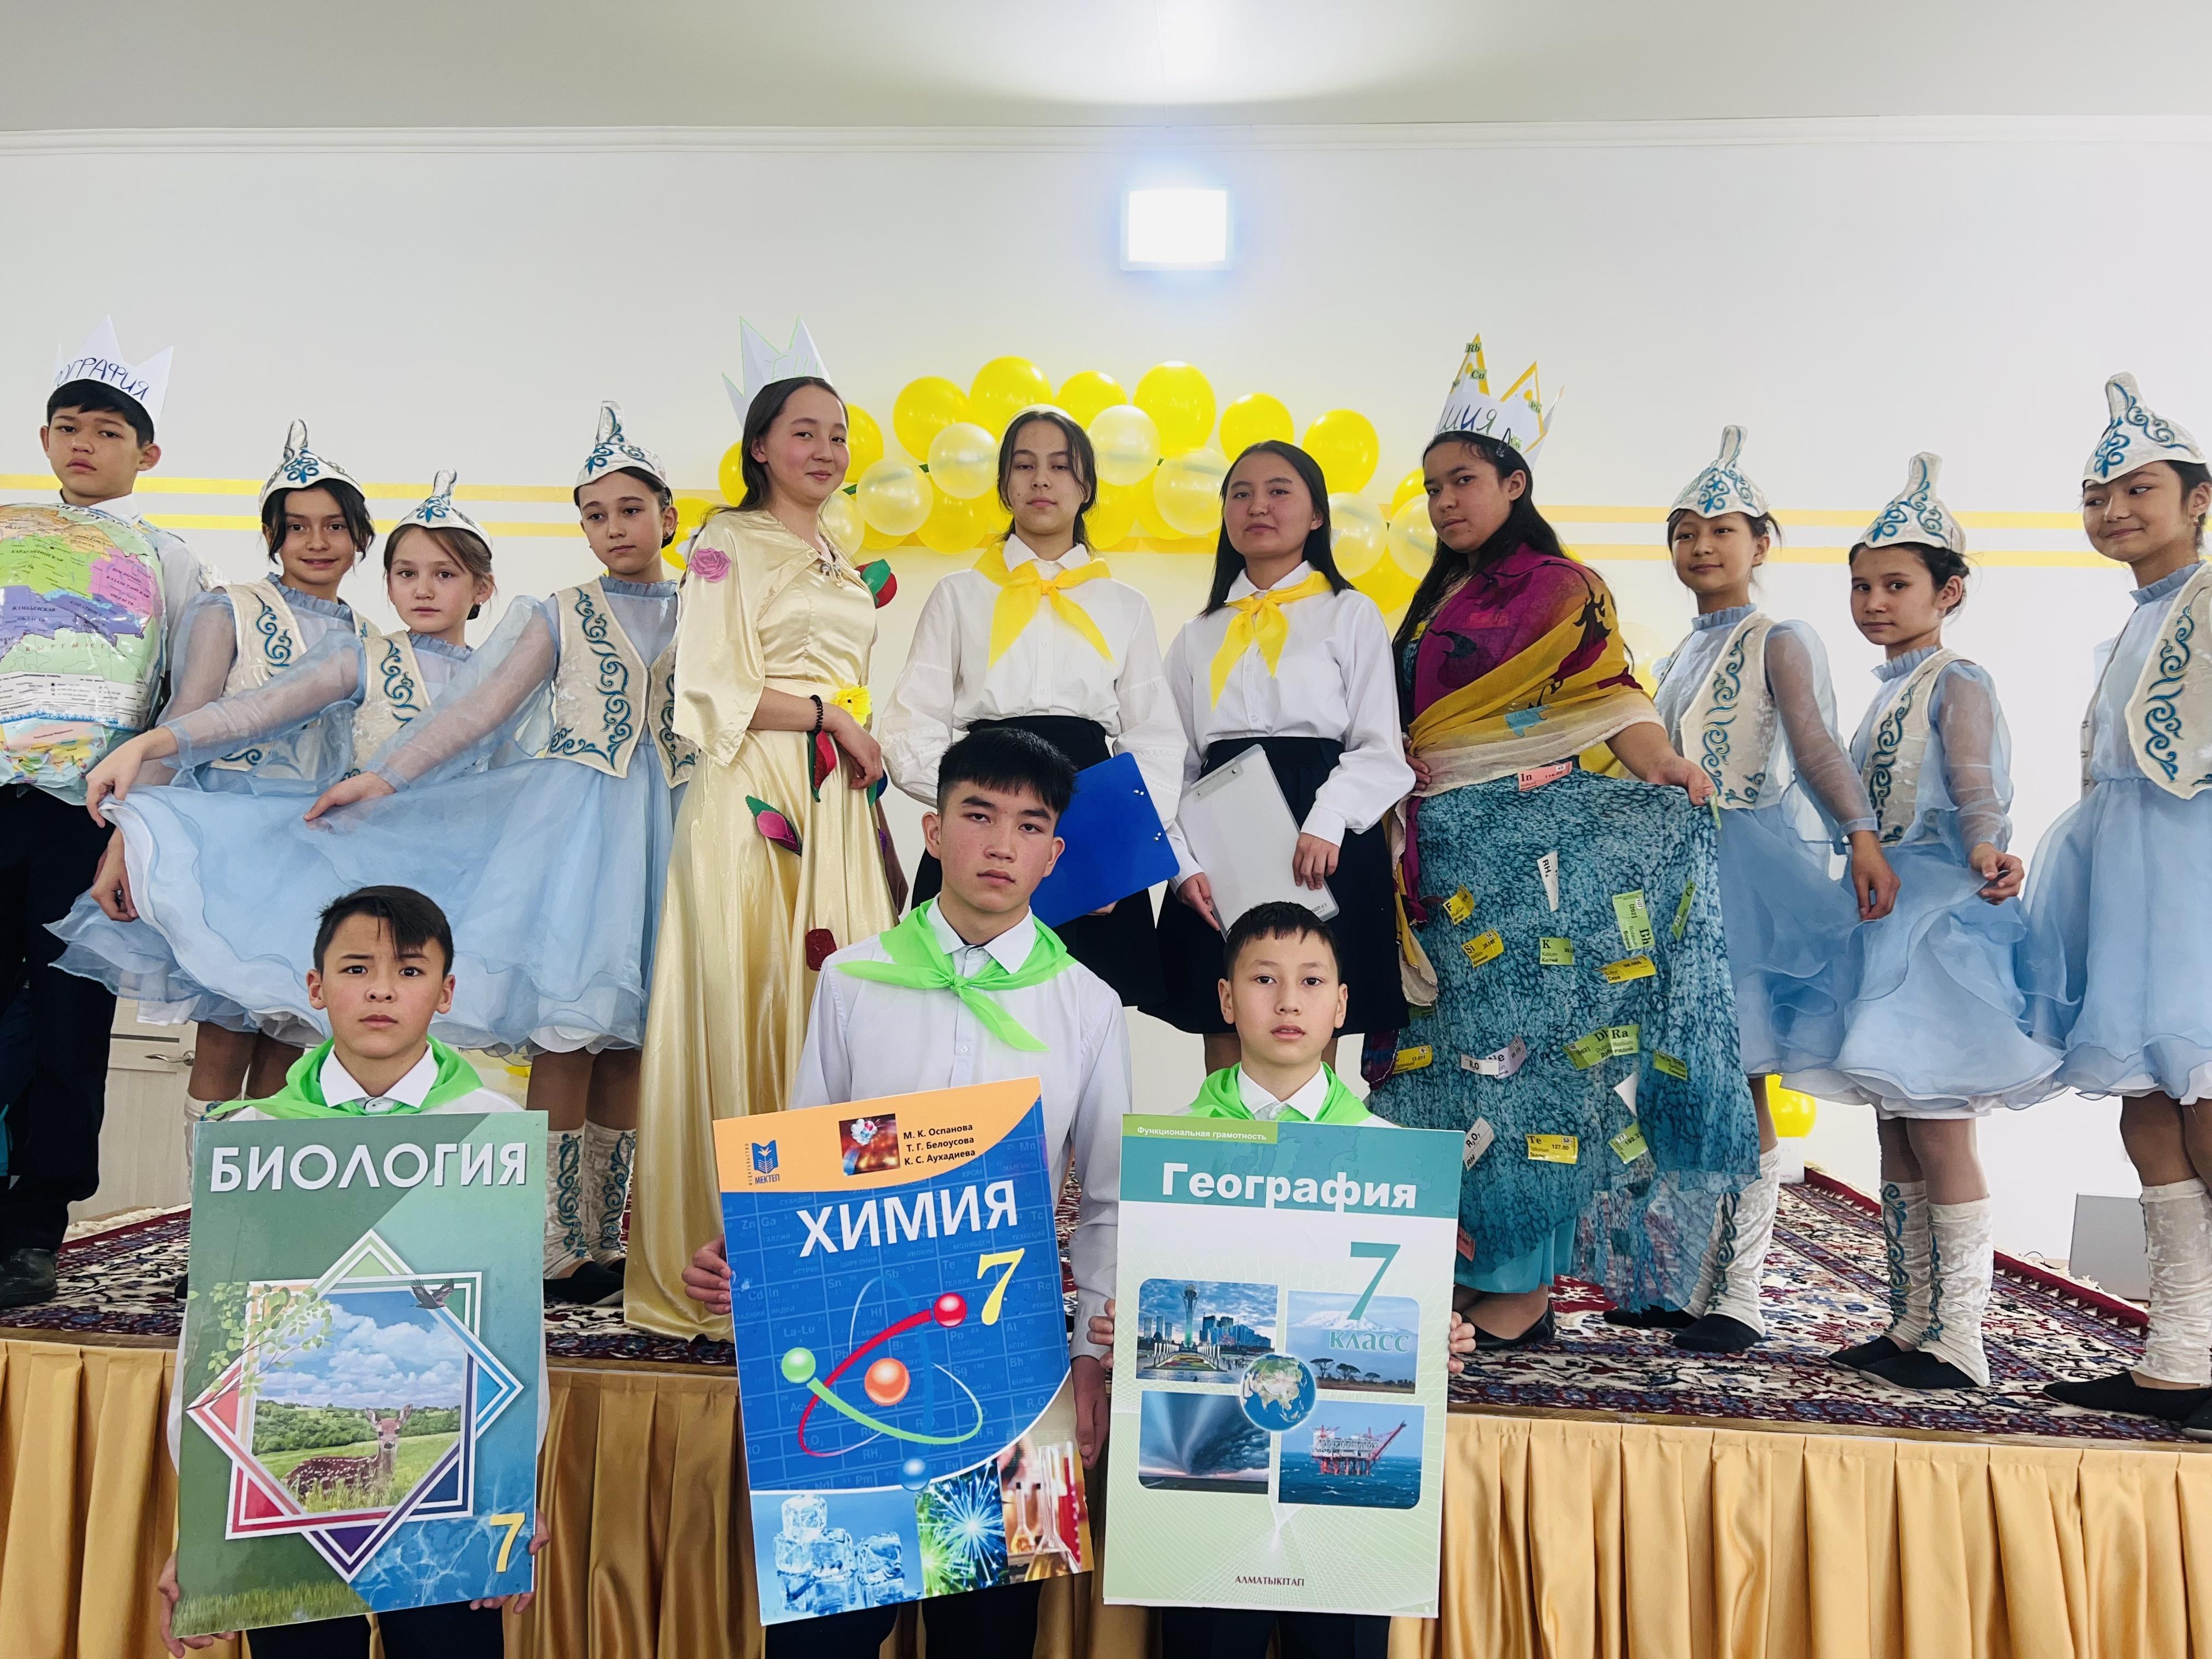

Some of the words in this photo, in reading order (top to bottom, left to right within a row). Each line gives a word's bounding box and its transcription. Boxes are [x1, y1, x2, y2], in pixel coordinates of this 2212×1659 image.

[1467, 344, 1480, 352] Rb
[1471, 370, 1485, 379] Cu
[1520, 774, 1532, 782] In
[1445, 902, 1452, 911] F
[1464, 943, 1476, 954] Si
[1542, 939, 1551, 949] K
[1612, 1029, 1629, 1039] Ra
[903, 1131, 915, 1139] М.
[917, 1130, 926, 1138] К.
[928, 1124, 973, 1136] Оспанова
[1137, 1126, 1211, 1138] Функциональная
[1212, 1131, 1267, 1141] грамотность
[906, 1144, 915, 1152] Т.
[917, 1143, 924, 1151] Г.
[926, 1137, 974, 1150] Белоусова
[1527, 1136, 1542, 1145] Te
[1020, 1142, 1036, 1152] Mn
[904, 1158, 913, 1166] К.
[916, 1155, 924, 1164] С.
[927, 1149, 976, 1163] Аухадиева
[1466, 1154, 1476, 1167] RH
[210, 1142, 527, 1193] БИОЛОГИЯ
[754, 1173, 780, 1185] МЕКТЕП
[1162, 1161, 1418, 1213] География
[796, 1179, 1018, 1258] ХИМИЯ
[1030, 1211, 1044, 1221] Tc
[741, 1220, 755, 1229] Zn
[761, 1217, 776, 1227] Ga
[942, 1260, 956, 1270] Te
[885, 1269, 899, 1279] Sb
[827, 1278, 842, 1289] Sn
[1037, 1281, 1052, 1290] Re
[1350, 1241, 1402, 1321] 7
[977, 1248, 1026, 1326] 7
[748, 1290, 764, 1301] Cd
[769, 1288, 780, 1298] In
[871, 1307, 883, 1318] Hf
[783, 1324, 815, 1338] La-Lu
[1007, 1322, 1018, 1332] At
[950, 1331, 964, 1341] Po
[1330, 1330, 1410, 1353] класс
[893, 1340, 904, 1351] Bi
[1009, 1357, 1023, 1368] Bh
[953, 1365, 967, 1377] Sg
[945, 1460, 959, 1471] Eu
[856, 1475, 873, 1485] Pm
[490, 1512, 526, 1573] 7
[1234, 1575, 1305, 1587] АЛМАТЫКІТАП
